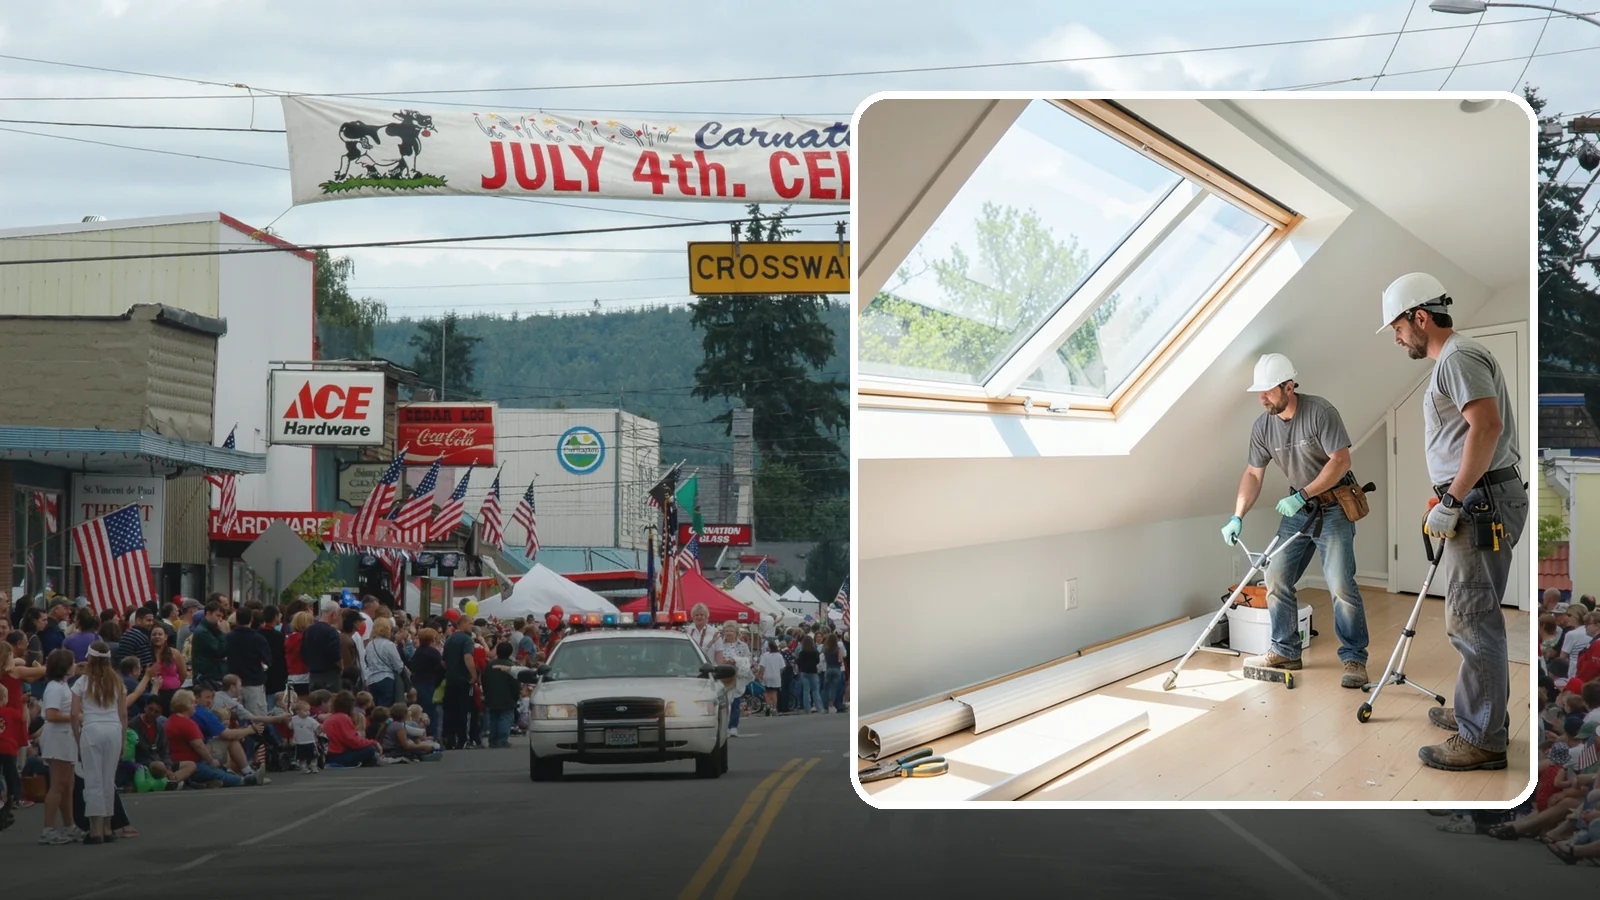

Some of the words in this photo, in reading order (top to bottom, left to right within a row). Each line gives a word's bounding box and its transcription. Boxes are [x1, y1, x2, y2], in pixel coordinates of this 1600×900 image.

[481, 140, 605, 193] JULY
[632, 150, 747, 198] 4th.
[697, 254, 850, 279] CROSSWA
[283, 380, 373, 420] ACE
[406, 409, 452, 421] CEDAR
[283, 421, 371, 436] Hardware
[416, 428, 476, 447] Coca-Cola
[354, 467, 385, 480] Simpl
[96, 485, 124, 495] Vincent
[126, 485, 136, 495] de
[137, 485, 155, 495] Paul
[688, 526, 741, 535] CRNATION
[699, 535, 730, 543] GLASS
